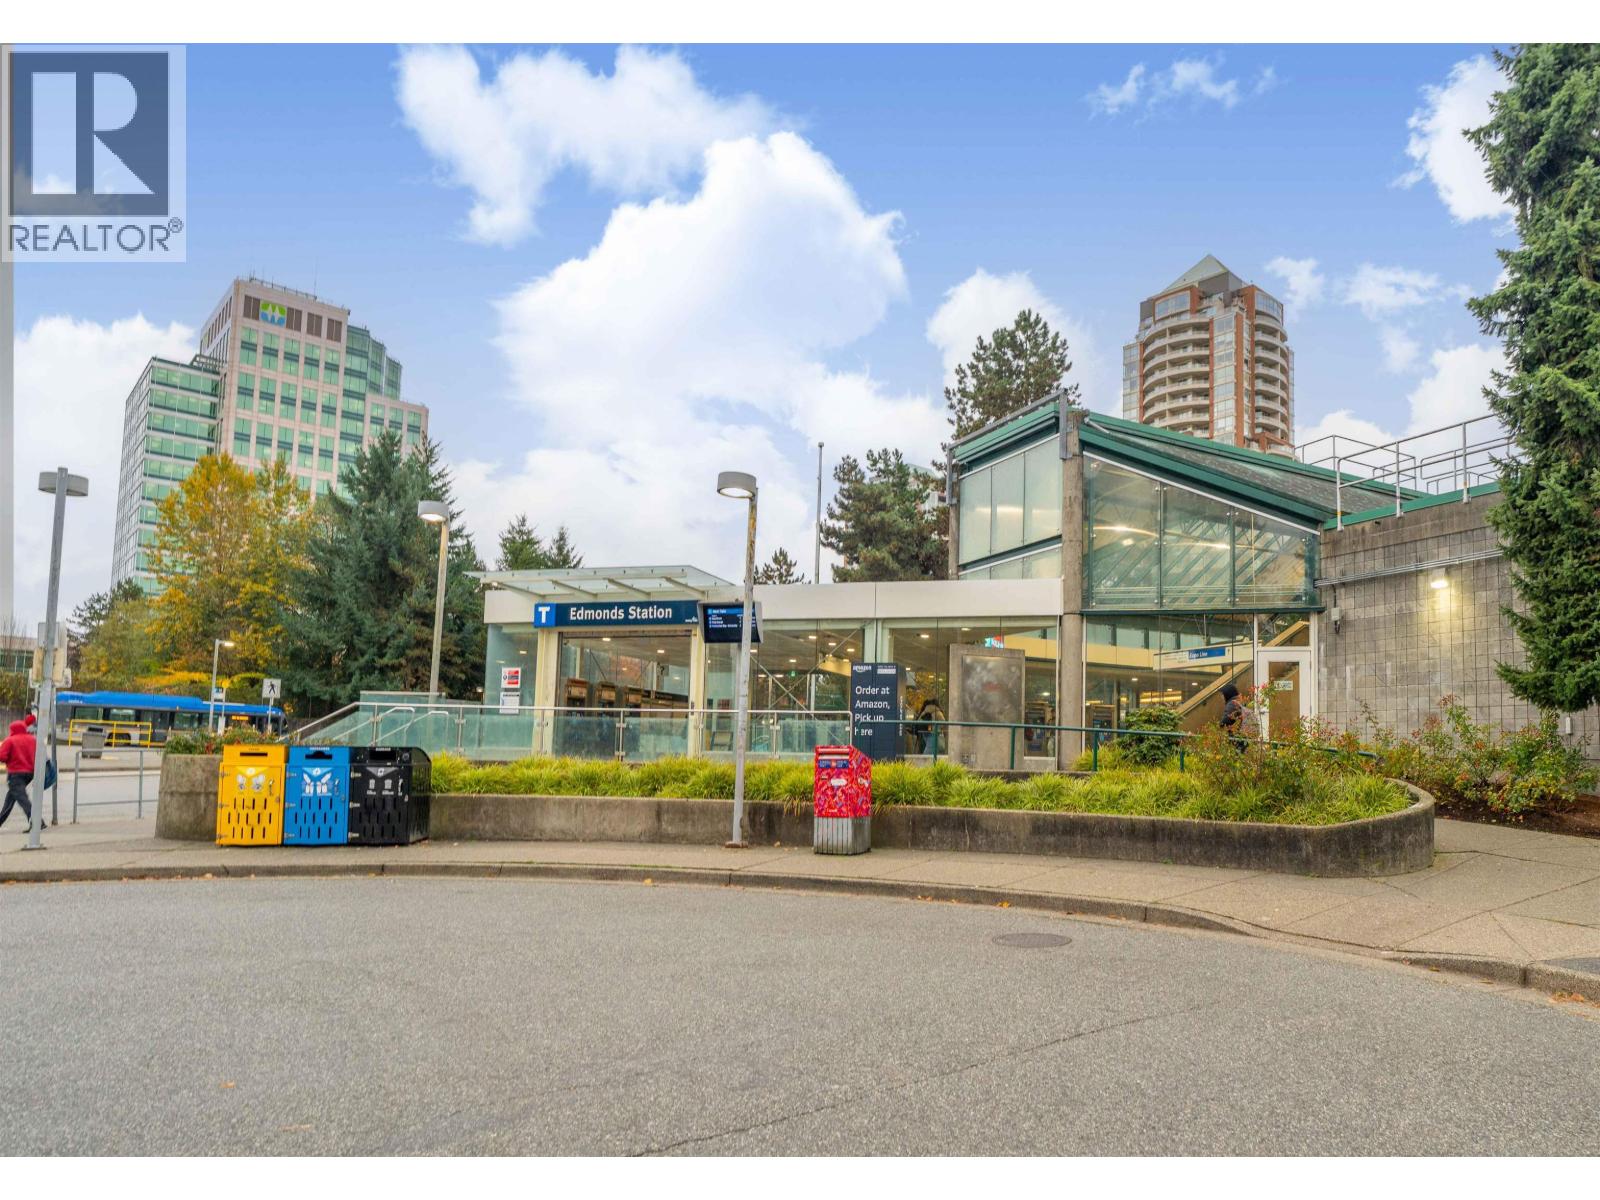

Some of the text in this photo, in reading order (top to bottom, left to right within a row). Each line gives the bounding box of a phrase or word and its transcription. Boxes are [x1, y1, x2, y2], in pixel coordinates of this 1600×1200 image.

[538, 606, 550, 624] T
[569, 606, 625, 621] Edmonds
[628, 605, 673, 620] Station
[855, 685, 890, 695] Order at
[854, 700, 890, 709] Amazon,
[854, 713, 871, 722] Pick
